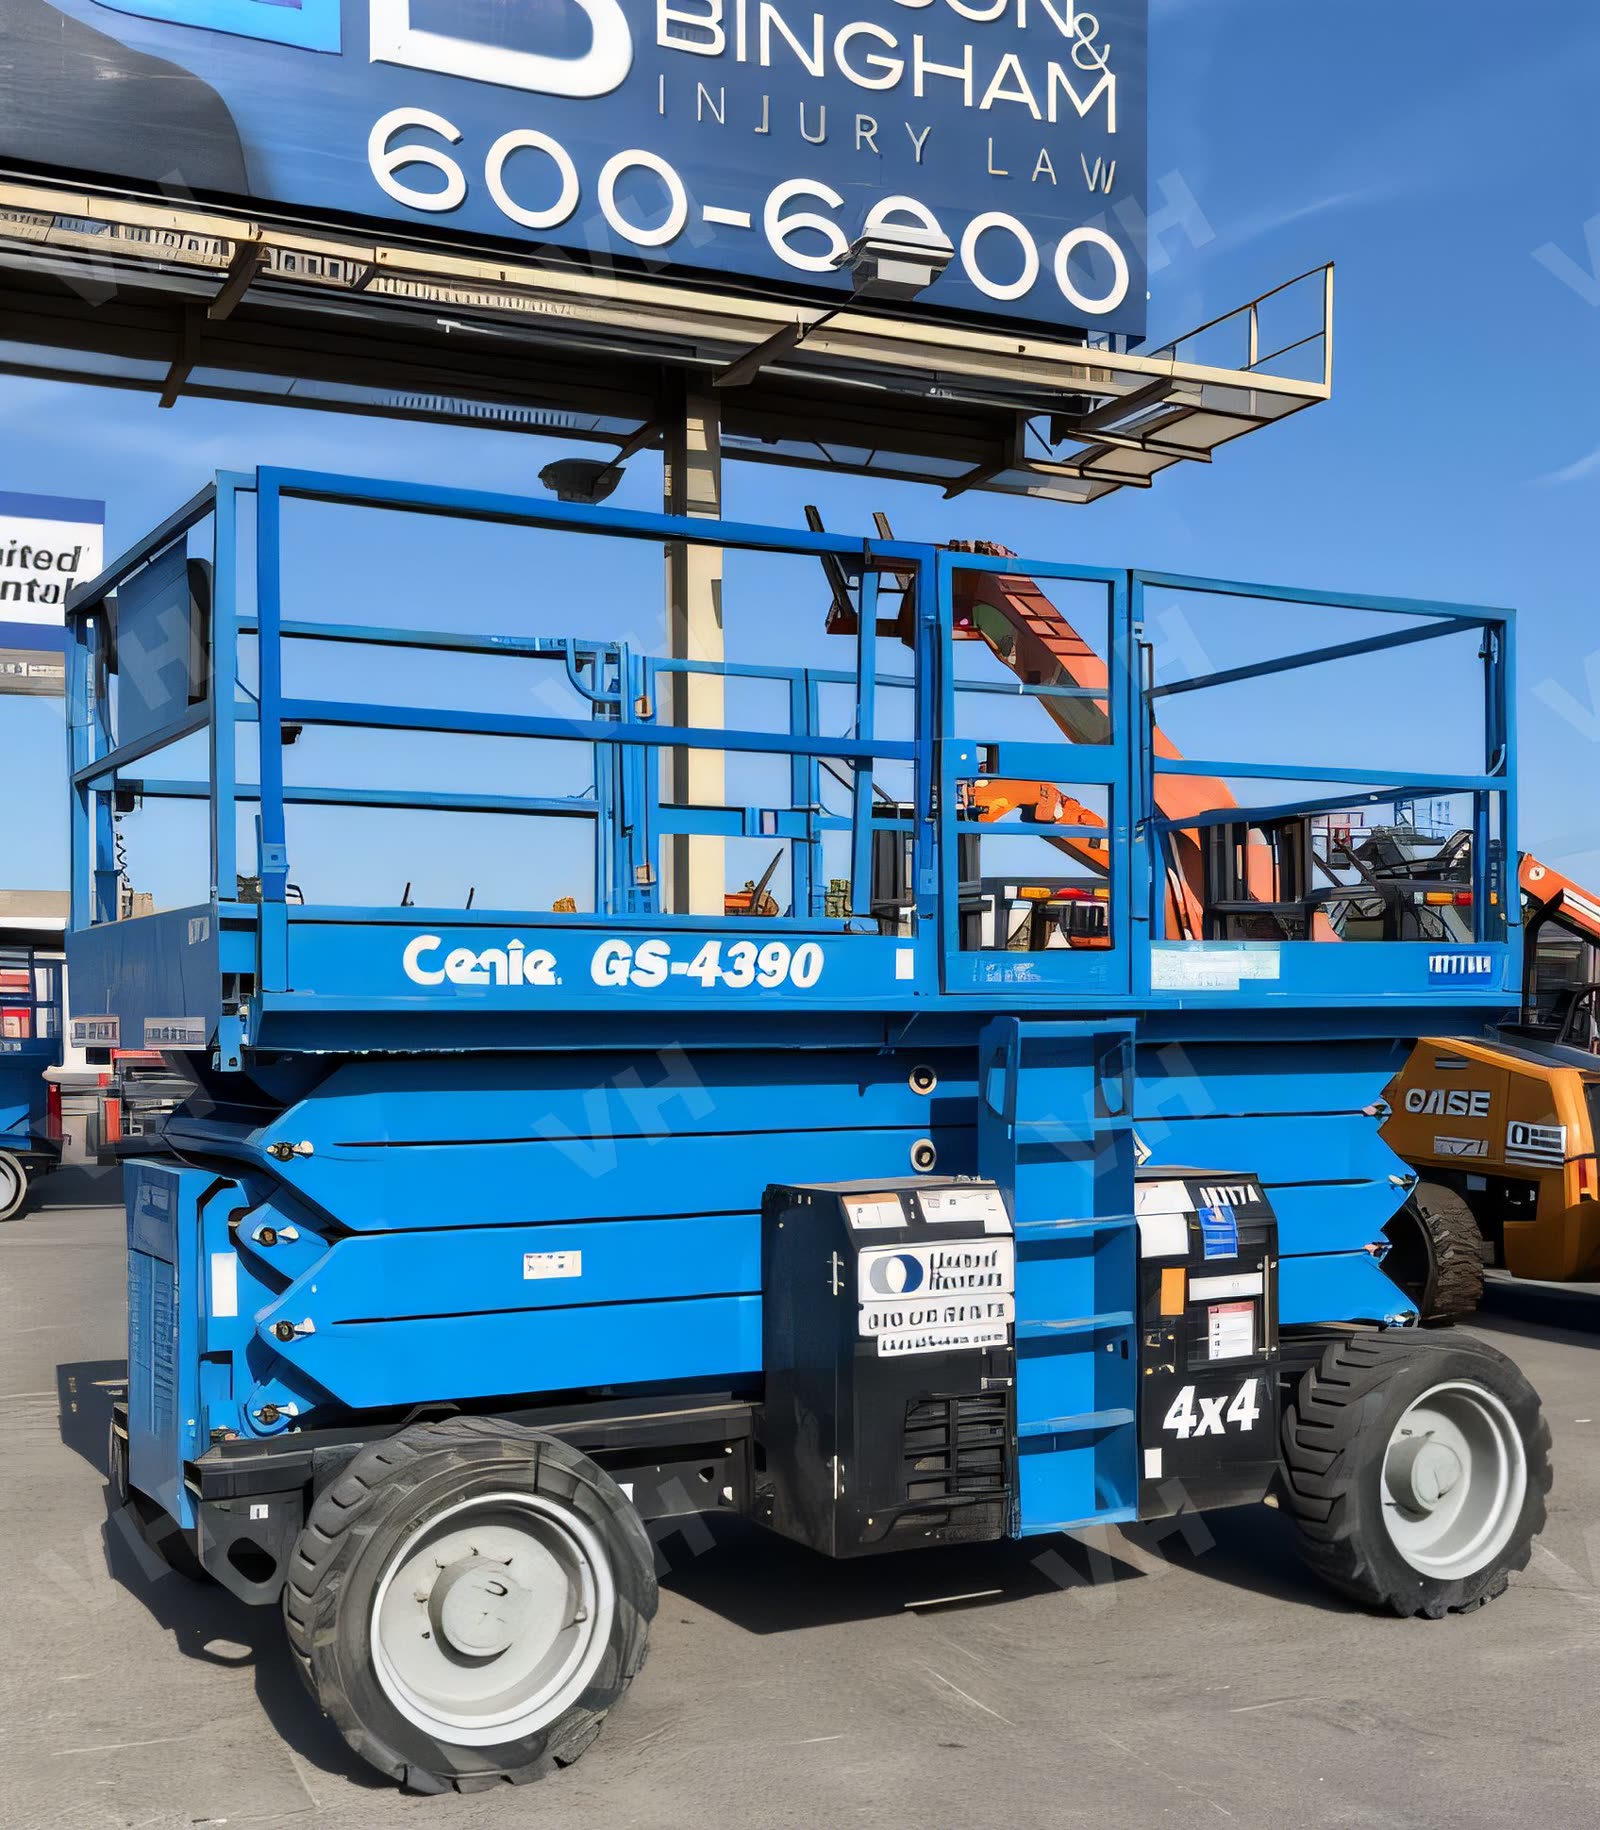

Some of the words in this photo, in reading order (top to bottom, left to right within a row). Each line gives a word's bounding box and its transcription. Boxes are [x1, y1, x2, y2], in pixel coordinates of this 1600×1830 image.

[656, 0, 1116, 134] BINGHAM
[658, 73, 932, 165] INJURY
[987, 136, 1117, 195] LAW
[590, 938, 825, 989] GS-4390
[1162, 1378, 1260, 1439] 4x4
